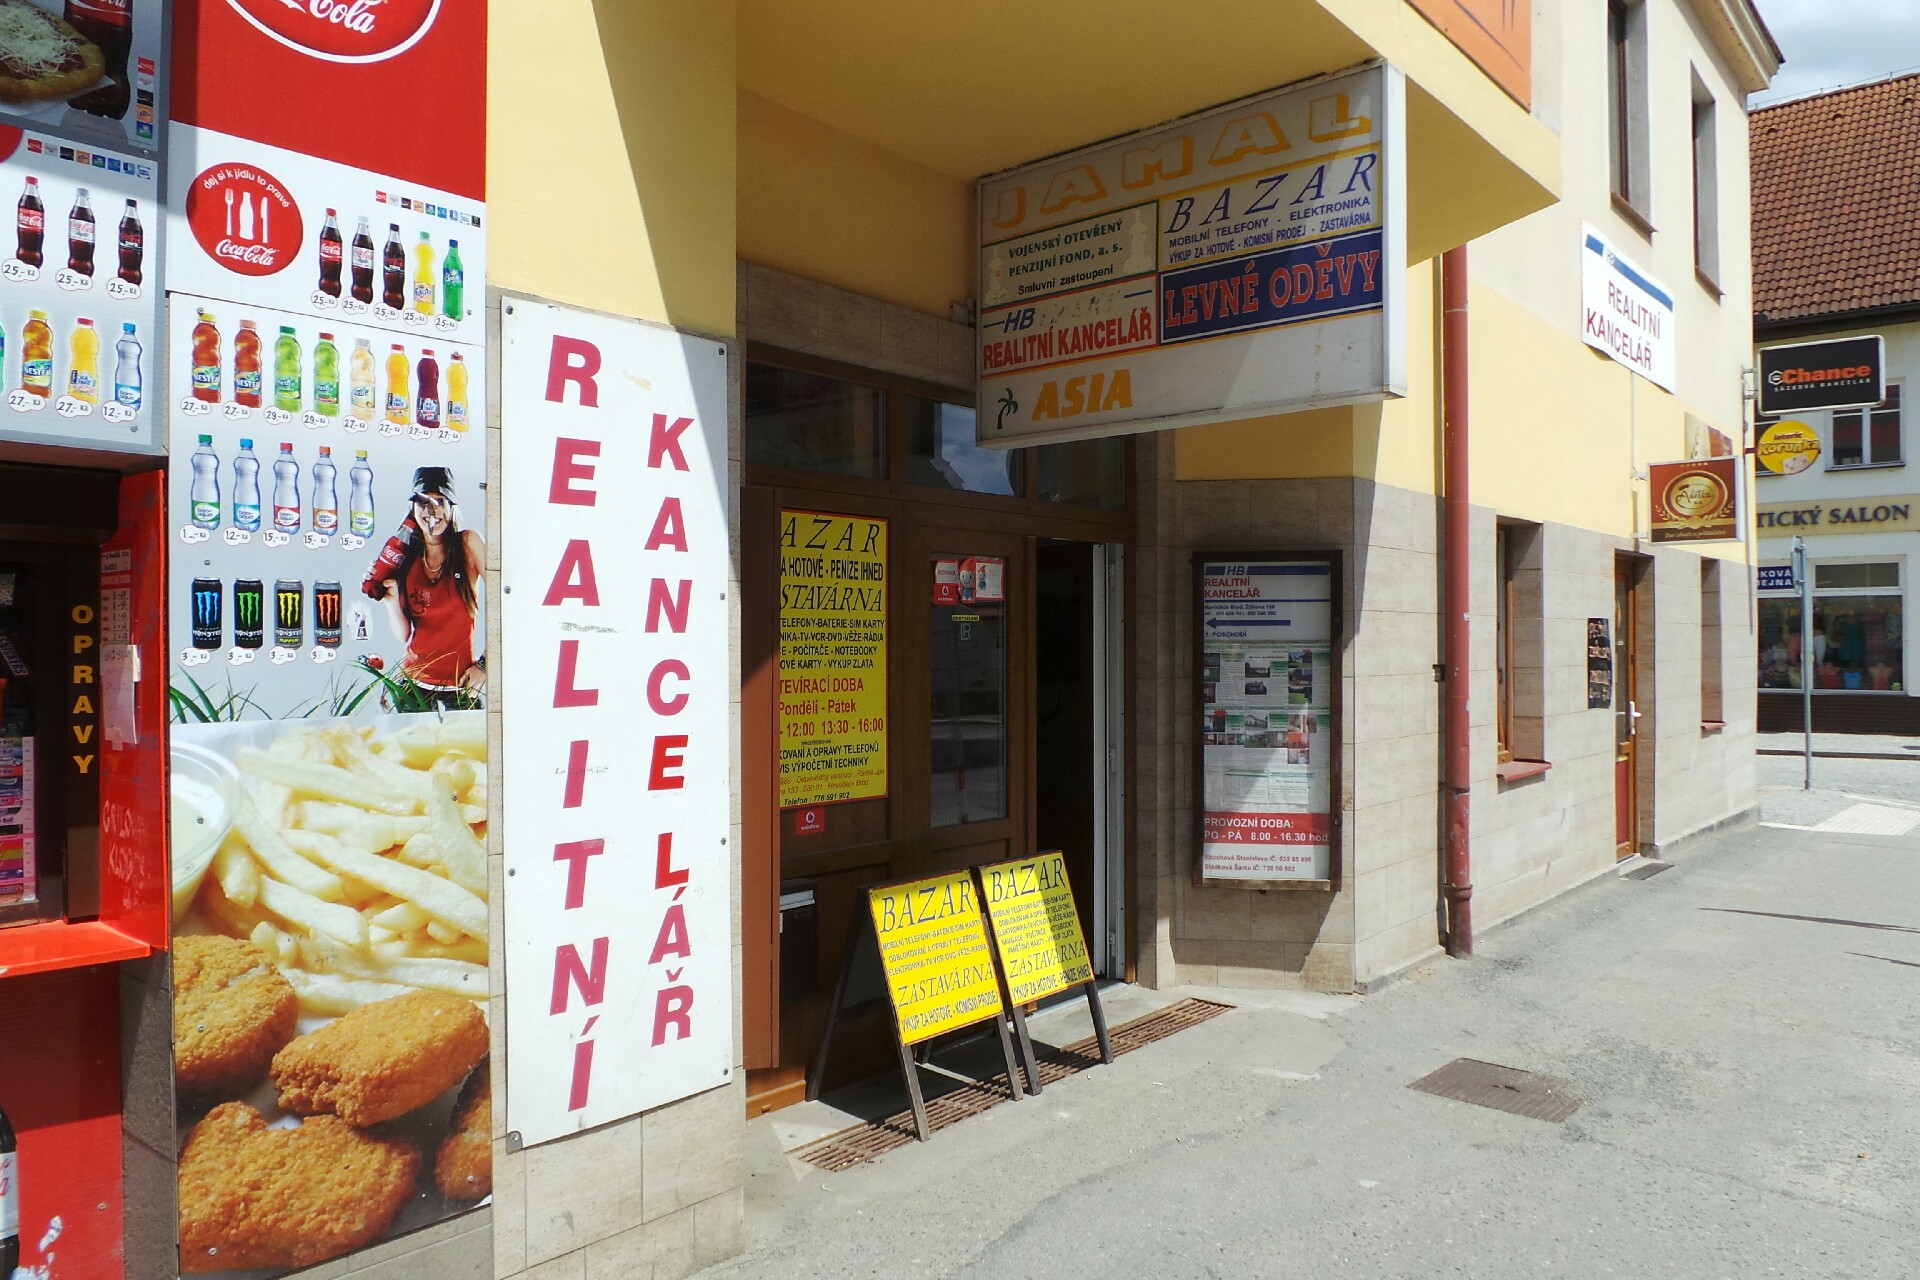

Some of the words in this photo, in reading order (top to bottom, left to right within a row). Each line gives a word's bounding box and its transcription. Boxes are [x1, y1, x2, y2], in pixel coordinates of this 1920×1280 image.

[990, 92, 1373, 231] JAMAL
[203, 175, 219, 189] dej
[217, 170, 226, 180] si
[225, 169, 233, 178] k
[234, 168, 255, 181] jídlu
[256, 175, 267, 186] to
[265, 183, 291, 208] pravé
[1163, 153, 1377, 235] BAZAR
[1008, 235, 1061, 258] VOJENSKÝ
[1063, 218, 1123, 245] OTEVŘENÝ
[1169, 229, 1210, 249] MOBILNÍ
[1215, 217, 1269, 238] TELEFONY
[1289, 196, 1371, 222] ELEKTRONIKA
[1169, 248, 1192, 264] VÝKUP
[1194, 248, 1204, 259] ZA
[1206, 239, 1235, 256] HOTOVÉ
[1243, 229, 1274, 247] KOMISNÍ
[1276, 225, 1307, 242] PRODEJ
[1320, 211, 1371, 231] ZASTAVÁRNA
[1009, 256, 1056, 277] PENZIJNÍ
[1059, 249, 1095, 265] FOND,
[1018, 278, 1055, 295] Smluvní
[1060, 264, 1114, 286] zastoupení
[1165, 260, 1260, 328] LEVNÉ
[1268, 242, 1380, 309] ODĚVY
[1003, 307, 1036, 333] HB
[1607, 280, 1661, 340] REALITNÍ
[983, 325, 1054, 370] REALITNÍ
[1058, 306, 1152, 356] KANCELÁŘ
[1586, 307, 1652, 371] KANCELÁŘ
[1782, 364, 1873, 385] Chance
[1031, 368, 1134, 422] ASIA
[1829, 504, 1911, 525] SALON
[788, 554, 824, 579] HOTOVÉ
[830, 555, 859, 580] PENÍZE
[861, 562, 884, 582] IHNED
[1204, 576, 1251, 587] REALITNÍ
[1226, 566, 1246, 576] HB
[1204, 588, 1261, 599] KANCELÁŘ
[863, 620, 885, 629] KARTY
[793, 644, 829, 656] POČÍTAČE
[834, 645, 878, 656] NOTEBOOKY
[797, 660, 822, 669] KARTY
[828, 658, 852, 669] VÝKUP
[853, 659, 874, 669] ZLATA
[71, 604, 94, 775] OPRAVY
[833, 678, 864, 693] DOBA
[828, 698, 857, 713] Pátek
[541, 334, 610, 1113] REALITNÍ
[643, 412, 696, 1049] KANCELÁŘ
[786, 721, 815, 737] 12:00
[822, 720, 849, 735] 13:30
[858, 718, 884, 733] 16:00
[814, 745, 842, 757] OPRAVY
[835, 757, 869, 768] TECHNIKY
[1204, 817, 1258, 829] PROVOZNÍ
[1260, 818, 1294, 829] DOBA:
[1204, 831, 1219, 840] PO
[1228, 829, 1243, 841] PÁ
[1250, 832, 1271, 841] 8.00
[1280, 833, 1306, 842] 16.30
[991, 857, 1067, 904] BAZAR
[880, 879, 975, 934] BAZAR
[1009, 940, 1087, 979] ZASTAVÁRNA
[897, 961, 994, 1008] ZASTAVÁRNA
